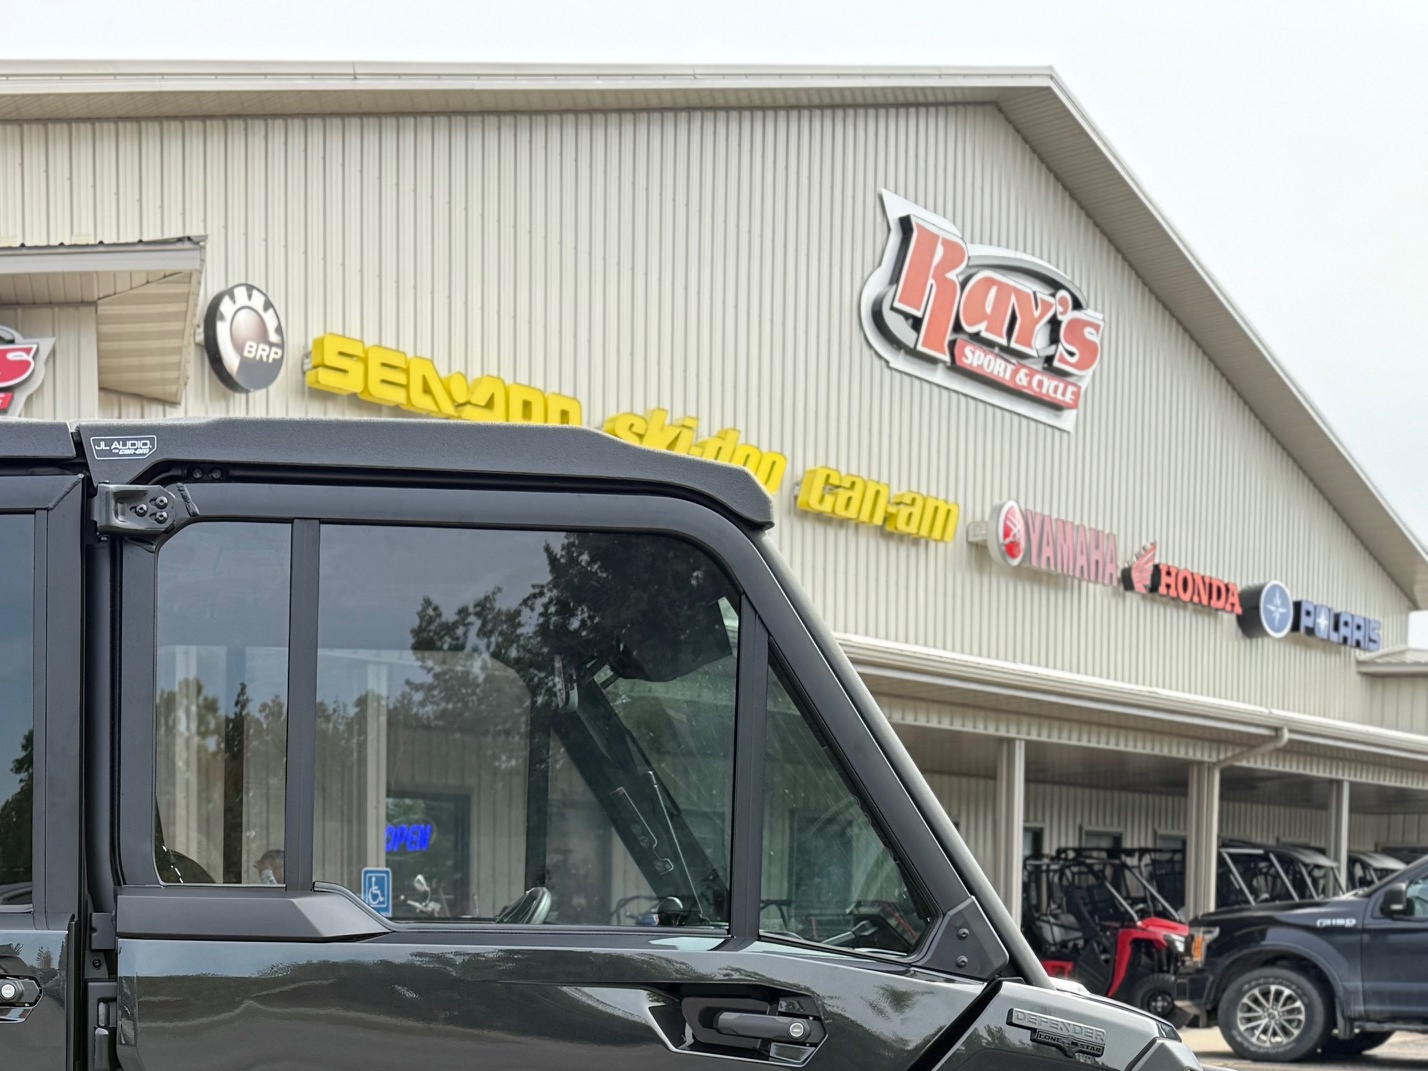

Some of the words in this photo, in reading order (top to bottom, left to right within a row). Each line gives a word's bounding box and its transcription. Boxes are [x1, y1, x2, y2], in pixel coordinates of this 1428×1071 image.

[243, 341, 283, 363] BRP
[961, 346, 1015, 382] SPORT
[1015, 369, 1030, 387] &
[1031, 373, 1077, 405] CYCLE
[95, 441, 110, 450] JL
[1025, 509, 1118, 587] YAMAHA
[1158, 563, 1243, 615] HONDA
[1296, 600, 1382, 652] POLARIS
[385, 824, 432, 852] OPEN
[1014, 1009, 1106, 1043] DEFENDER
[1079, 1042, 1103, 1053] STAR
